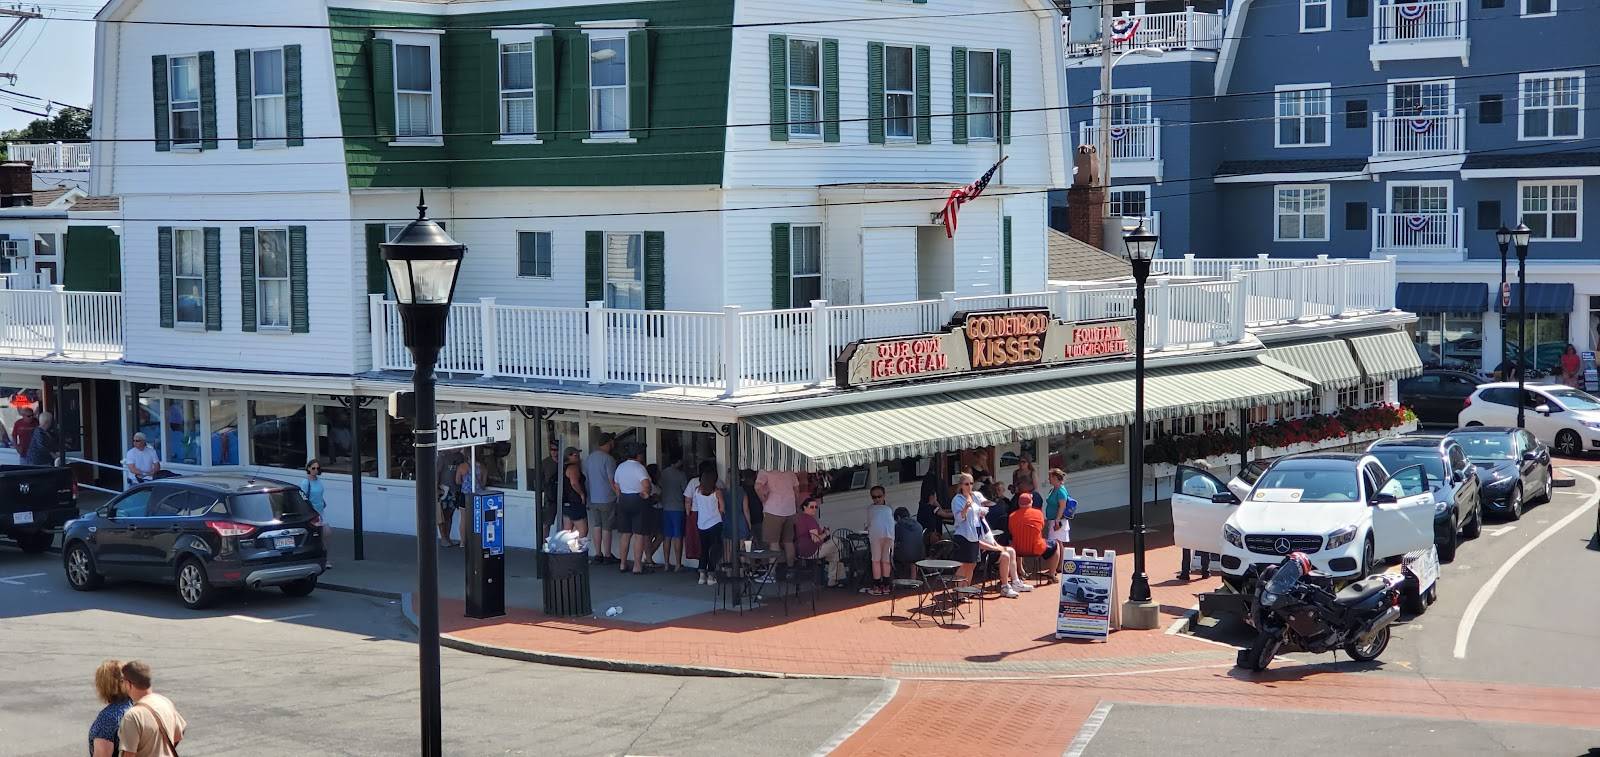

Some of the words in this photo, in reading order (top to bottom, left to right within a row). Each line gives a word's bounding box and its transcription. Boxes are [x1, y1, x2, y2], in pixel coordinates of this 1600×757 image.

[968, 312, 1048, 339] GOLDENROD
[876, 341, 910, 358] OUR
[912, 337, 941, 354] OWN
[973, 336, 1042, 367] KISSES
[870, 358, 895, 379] ICE
[896, 353, 948, 375] CREAM
[441, 416, 488, 441] BEACH
[496, 420, 504, 431] ST
